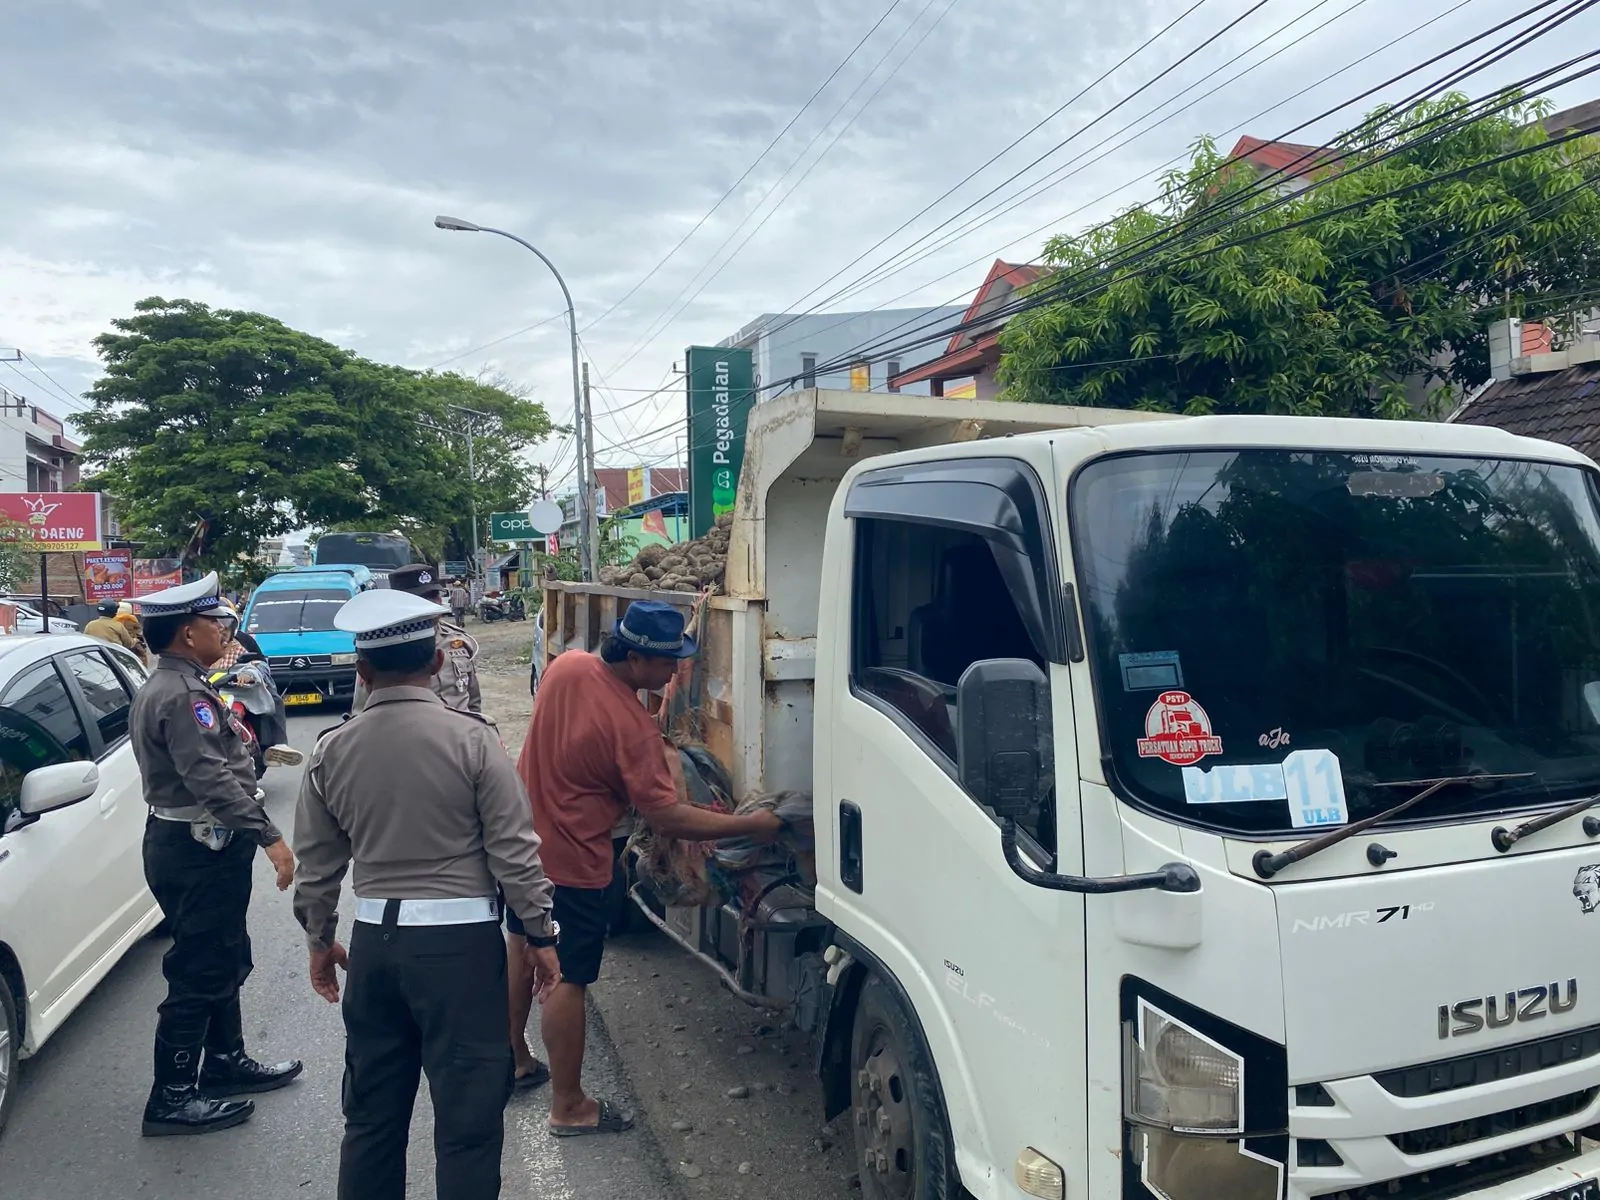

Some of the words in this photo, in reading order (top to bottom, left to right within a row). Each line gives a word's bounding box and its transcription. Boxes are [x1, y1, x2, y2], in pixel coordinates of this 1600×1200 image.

[712, 361, 734, 464] Pegadaian
[40, 527, 84, 539] DAENG
[500, 519, 531, 530] opp
[1140, 740, 1178, 754] PERSATUAN
[1200, 739, 1220, 752] TRUCK
[1184, 766, 1286, 801] ULB
[1287, 754, 1340, 806] 11
[1302, 807, 1342, 824] ULB
[1291, 911, 1370, 933] NMR
[1377, 905, 1410, 923] 71
[943, 959, 964, 977] ISUZU
[946, 972, 996, 1008] ELF
[1437, 976, 1578, 1040] ISUZU
